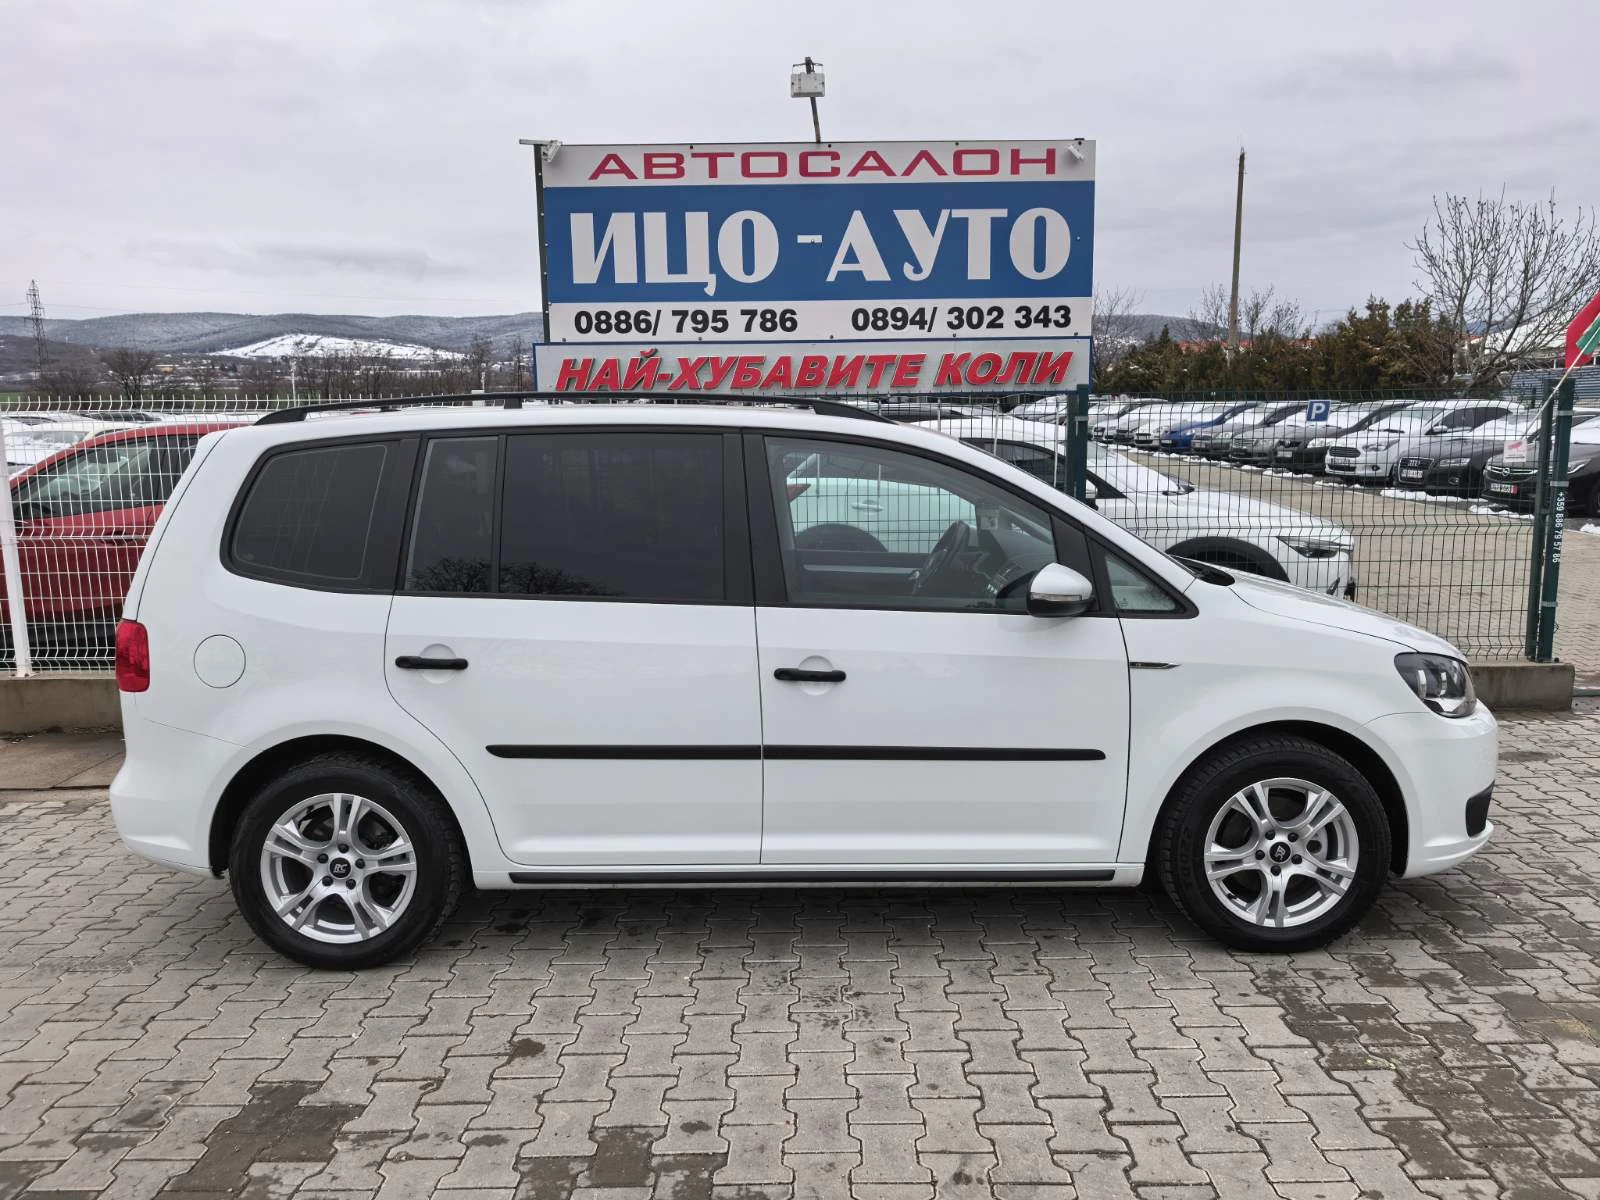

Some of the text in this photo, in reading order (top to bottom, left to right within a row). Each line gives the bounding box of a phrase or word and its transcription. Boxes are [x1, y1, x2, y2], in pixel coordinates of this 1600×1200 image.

[588, 148, 1056, 180] АВТОСАЛОН
[574, 308, 798, 335] 0886/ 795 786
[851, 306, 1071, 333] 0894/ 302 343
[555, 349, 1074, 391] НАЙ-ХУБАВИТЕ КОЛИ
[1310, 402, 1326, 419] P
